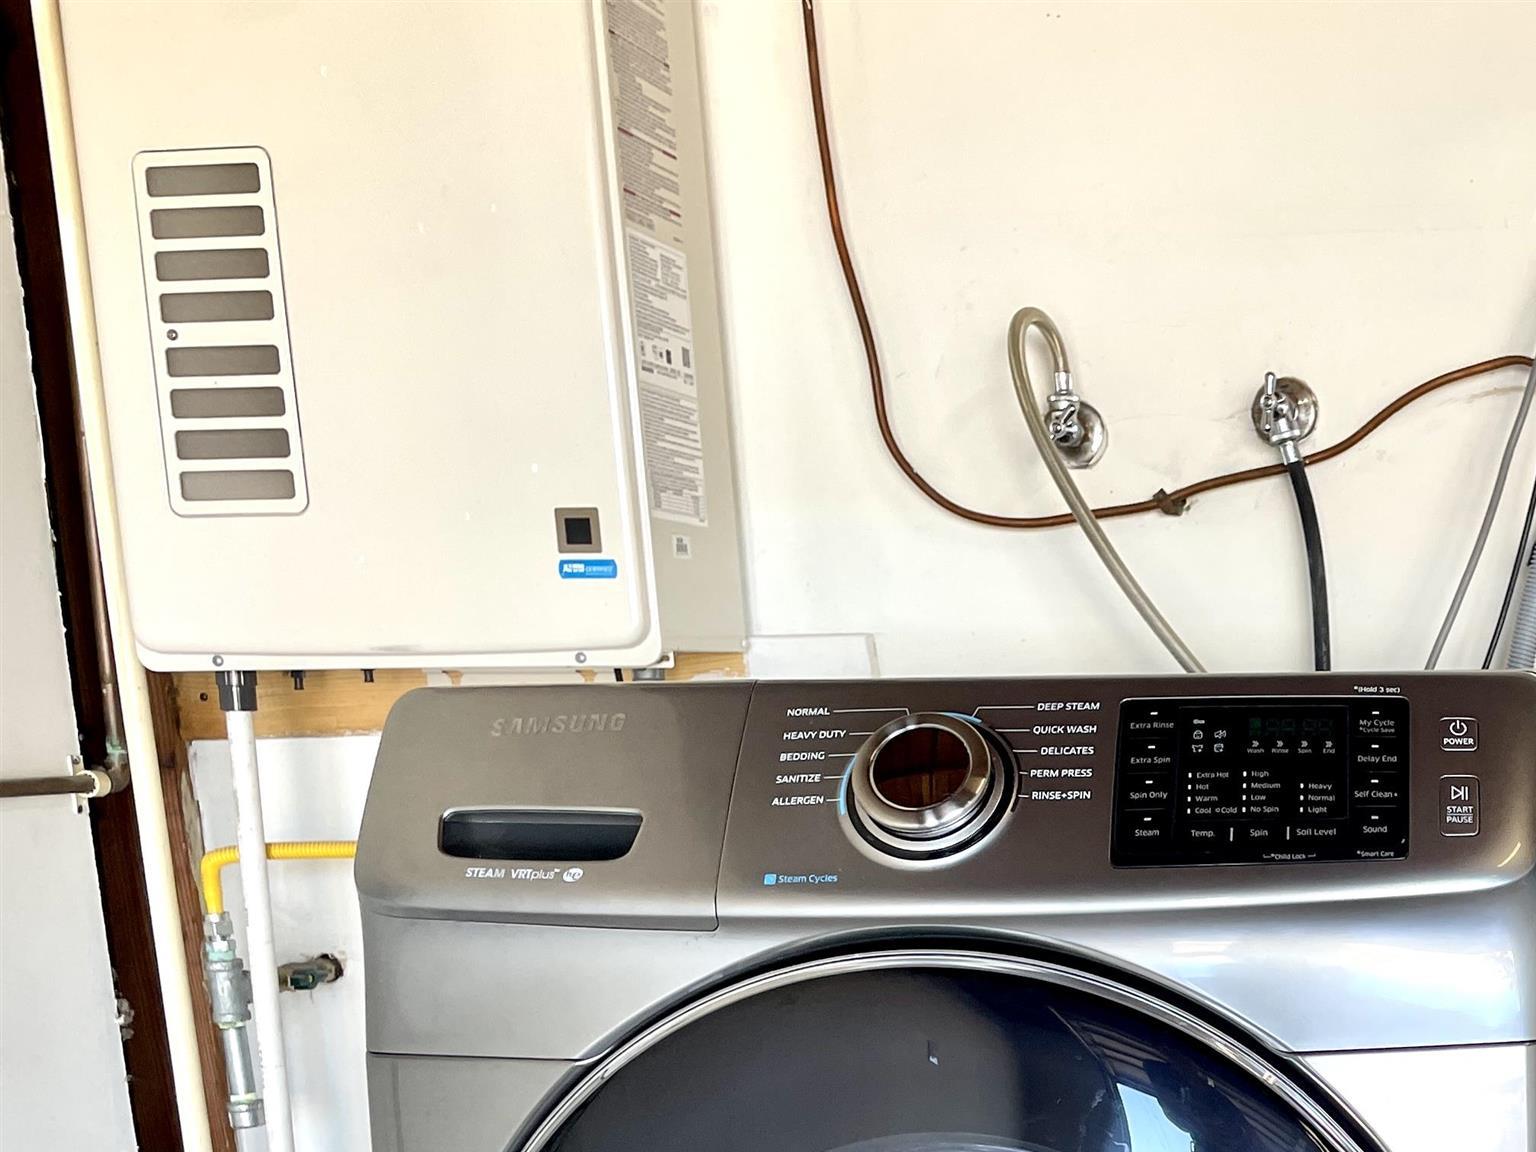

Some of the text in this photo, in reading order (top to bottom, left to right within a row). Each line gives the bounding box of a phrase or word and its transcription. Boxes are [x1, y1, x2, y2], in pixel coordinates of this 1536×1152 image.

[1066, 702, 1100, 710] STEAM
[787, 708, 830, 716] NORMAL
[491, 713, 626, 736] SAMSUNG
[1033, 725, 1097, 734] QUICK WASH
[783, 730, 846, 740] HEAVY DUTY
[1041, 747, 1094, 755] DELICATES
[780, 752, 825, 761] BEDDING
[1358, 755, 1380, 763] Delay
[1030, 769, 1092, 777] PERM PRESS
[776, 774, 821, 783] SANITIZE
[1354, 790, 1369, 798] Self
[772, 796, 824, 805] ALLERGEN
[1250, 829, 1268, 837] Spin
[1296, 828, 1312, 836] Soil
[465, 868, 505, 878] STEAM
[778, 875, 837, 884] Steam Cycles
